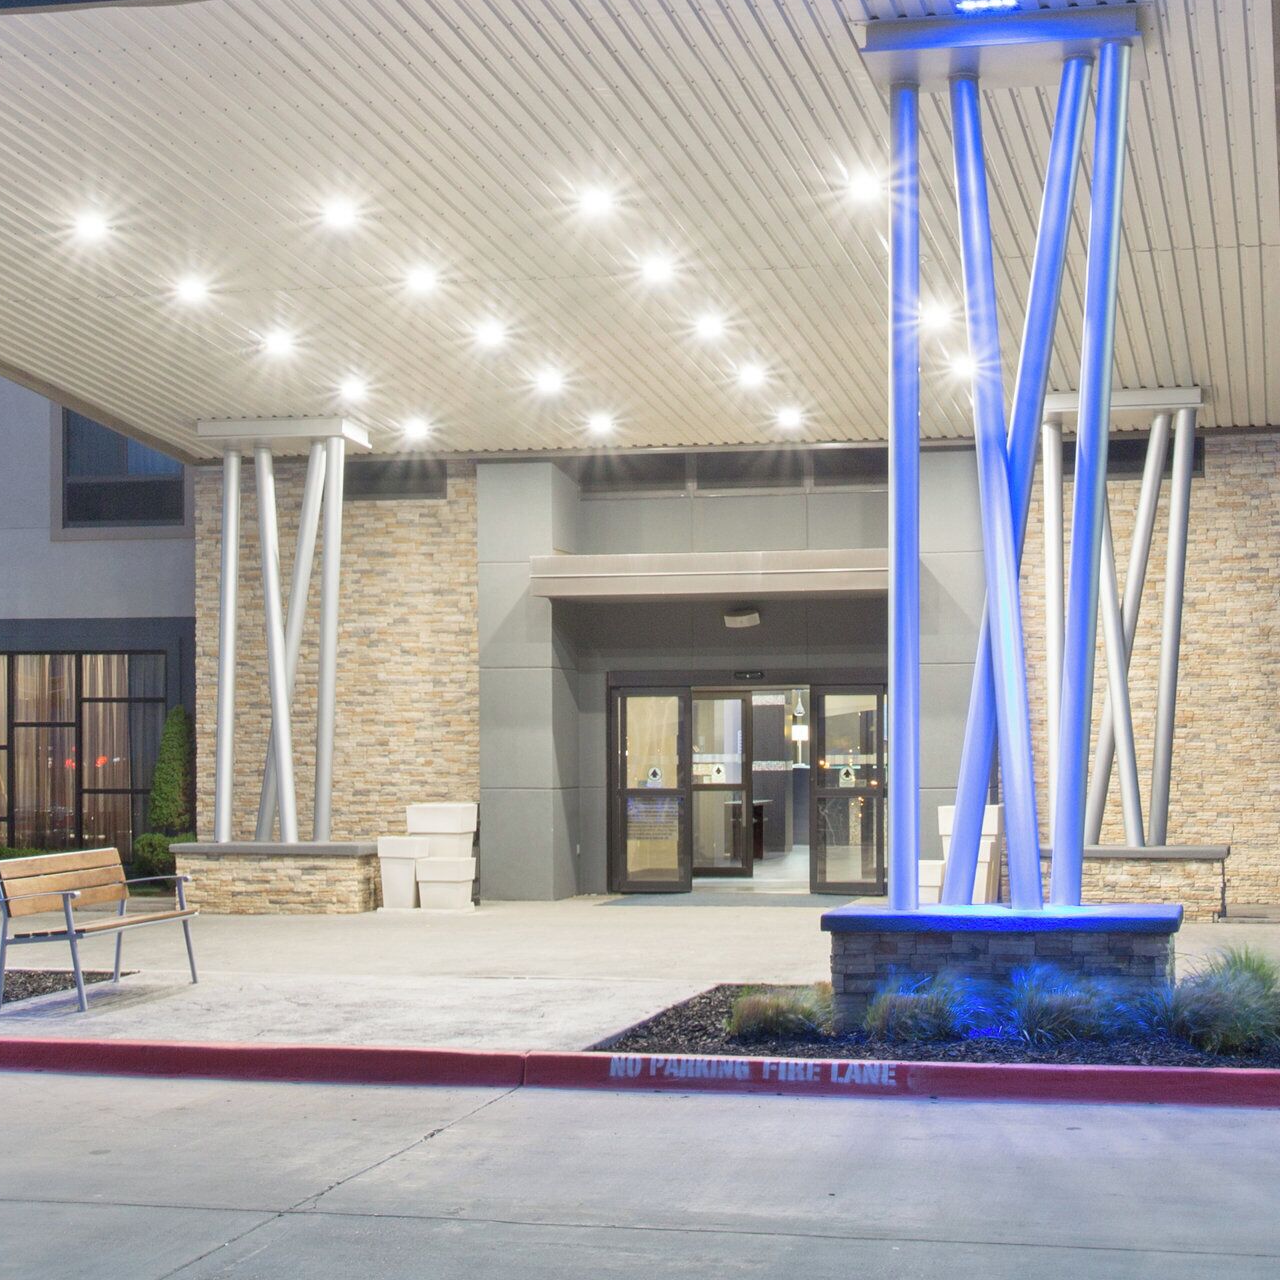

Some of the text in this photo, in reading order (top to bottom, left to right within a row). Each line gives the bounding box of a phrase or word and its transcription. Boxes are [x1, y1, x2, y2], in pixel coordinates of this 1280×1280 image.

[609, 1055, 897, 1087] NO PARKING FIRE LANE
